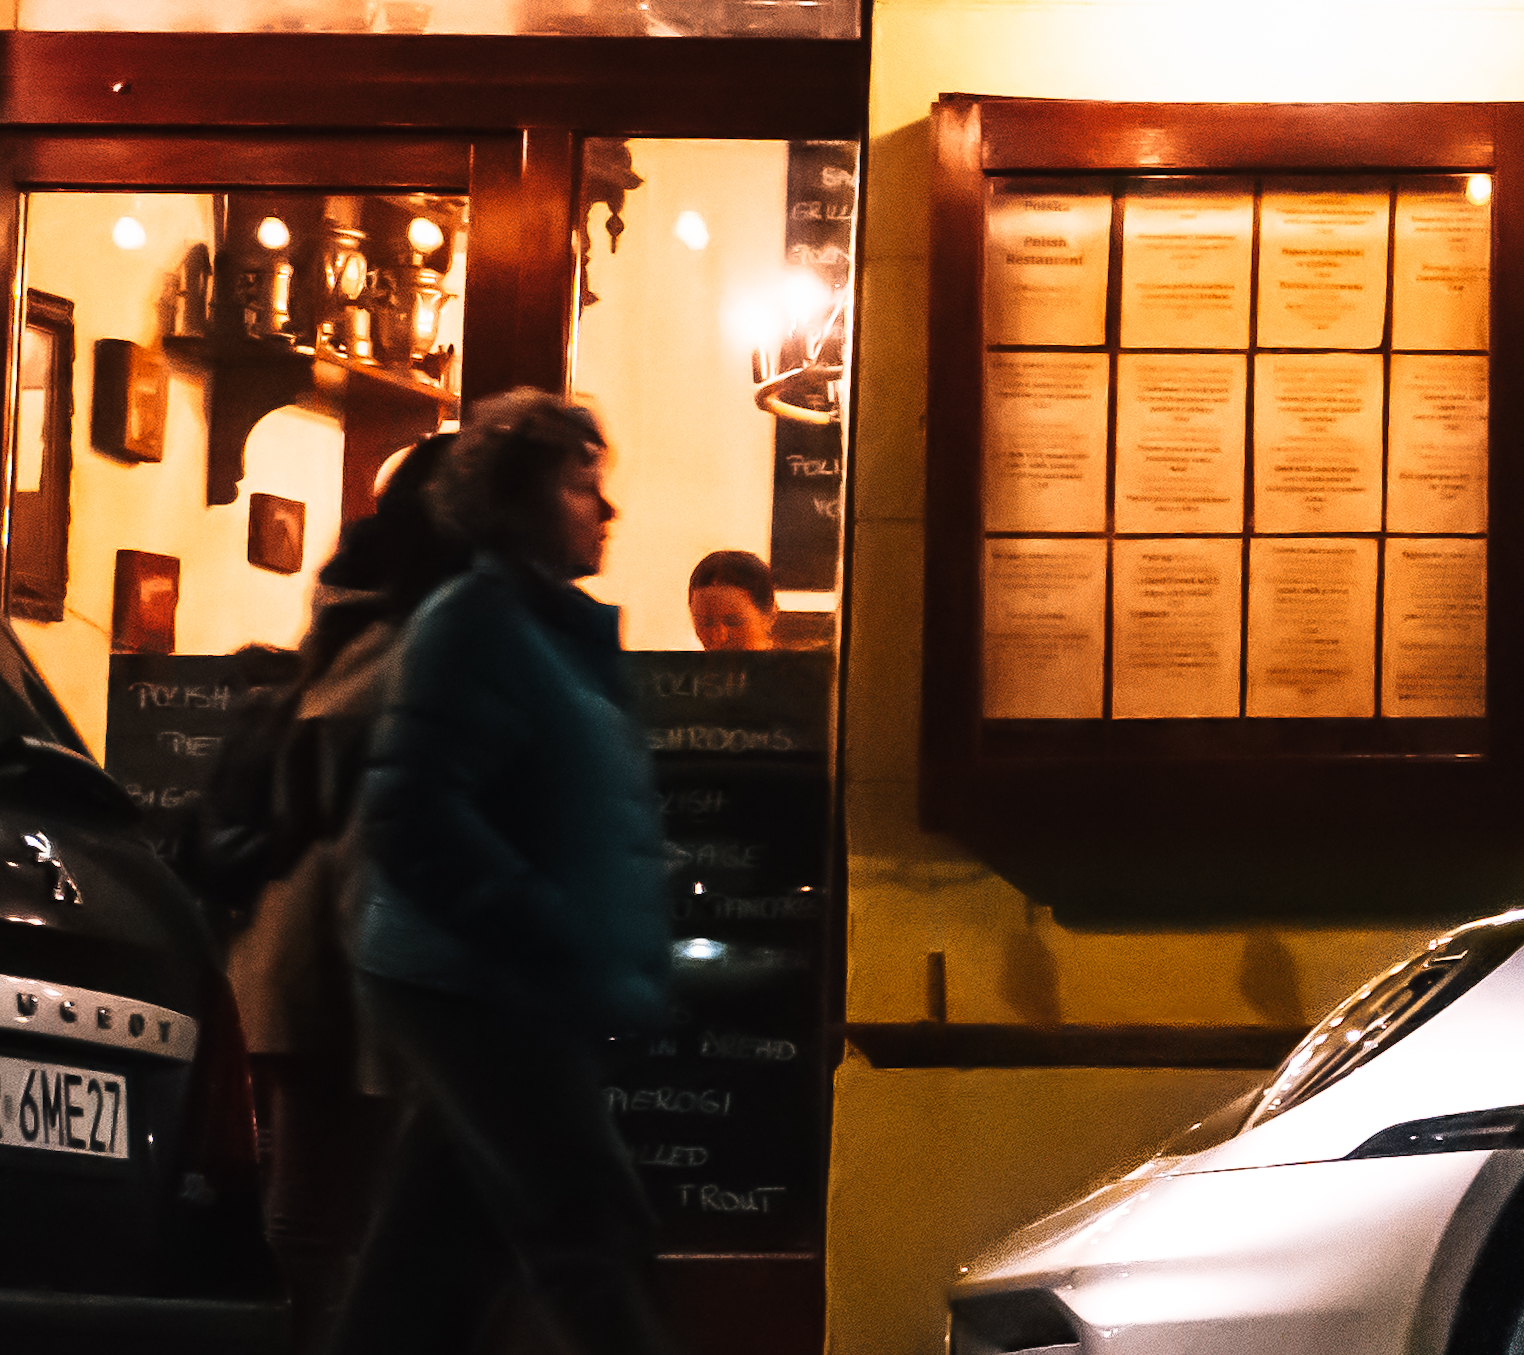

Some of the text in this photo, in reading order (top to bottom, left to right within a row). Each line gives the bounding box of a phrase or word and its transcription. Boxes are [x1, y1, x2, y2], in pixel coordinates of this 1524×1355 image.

[128, 681, 230, 711] POLISH
[16, 991, 172, 1043] UGEOT
[19, 1068, 120, 1154] 6ME27
[601, 1086, 734, 1117] PIEROGI
[675, 1183, 788, 1214] TROUT
